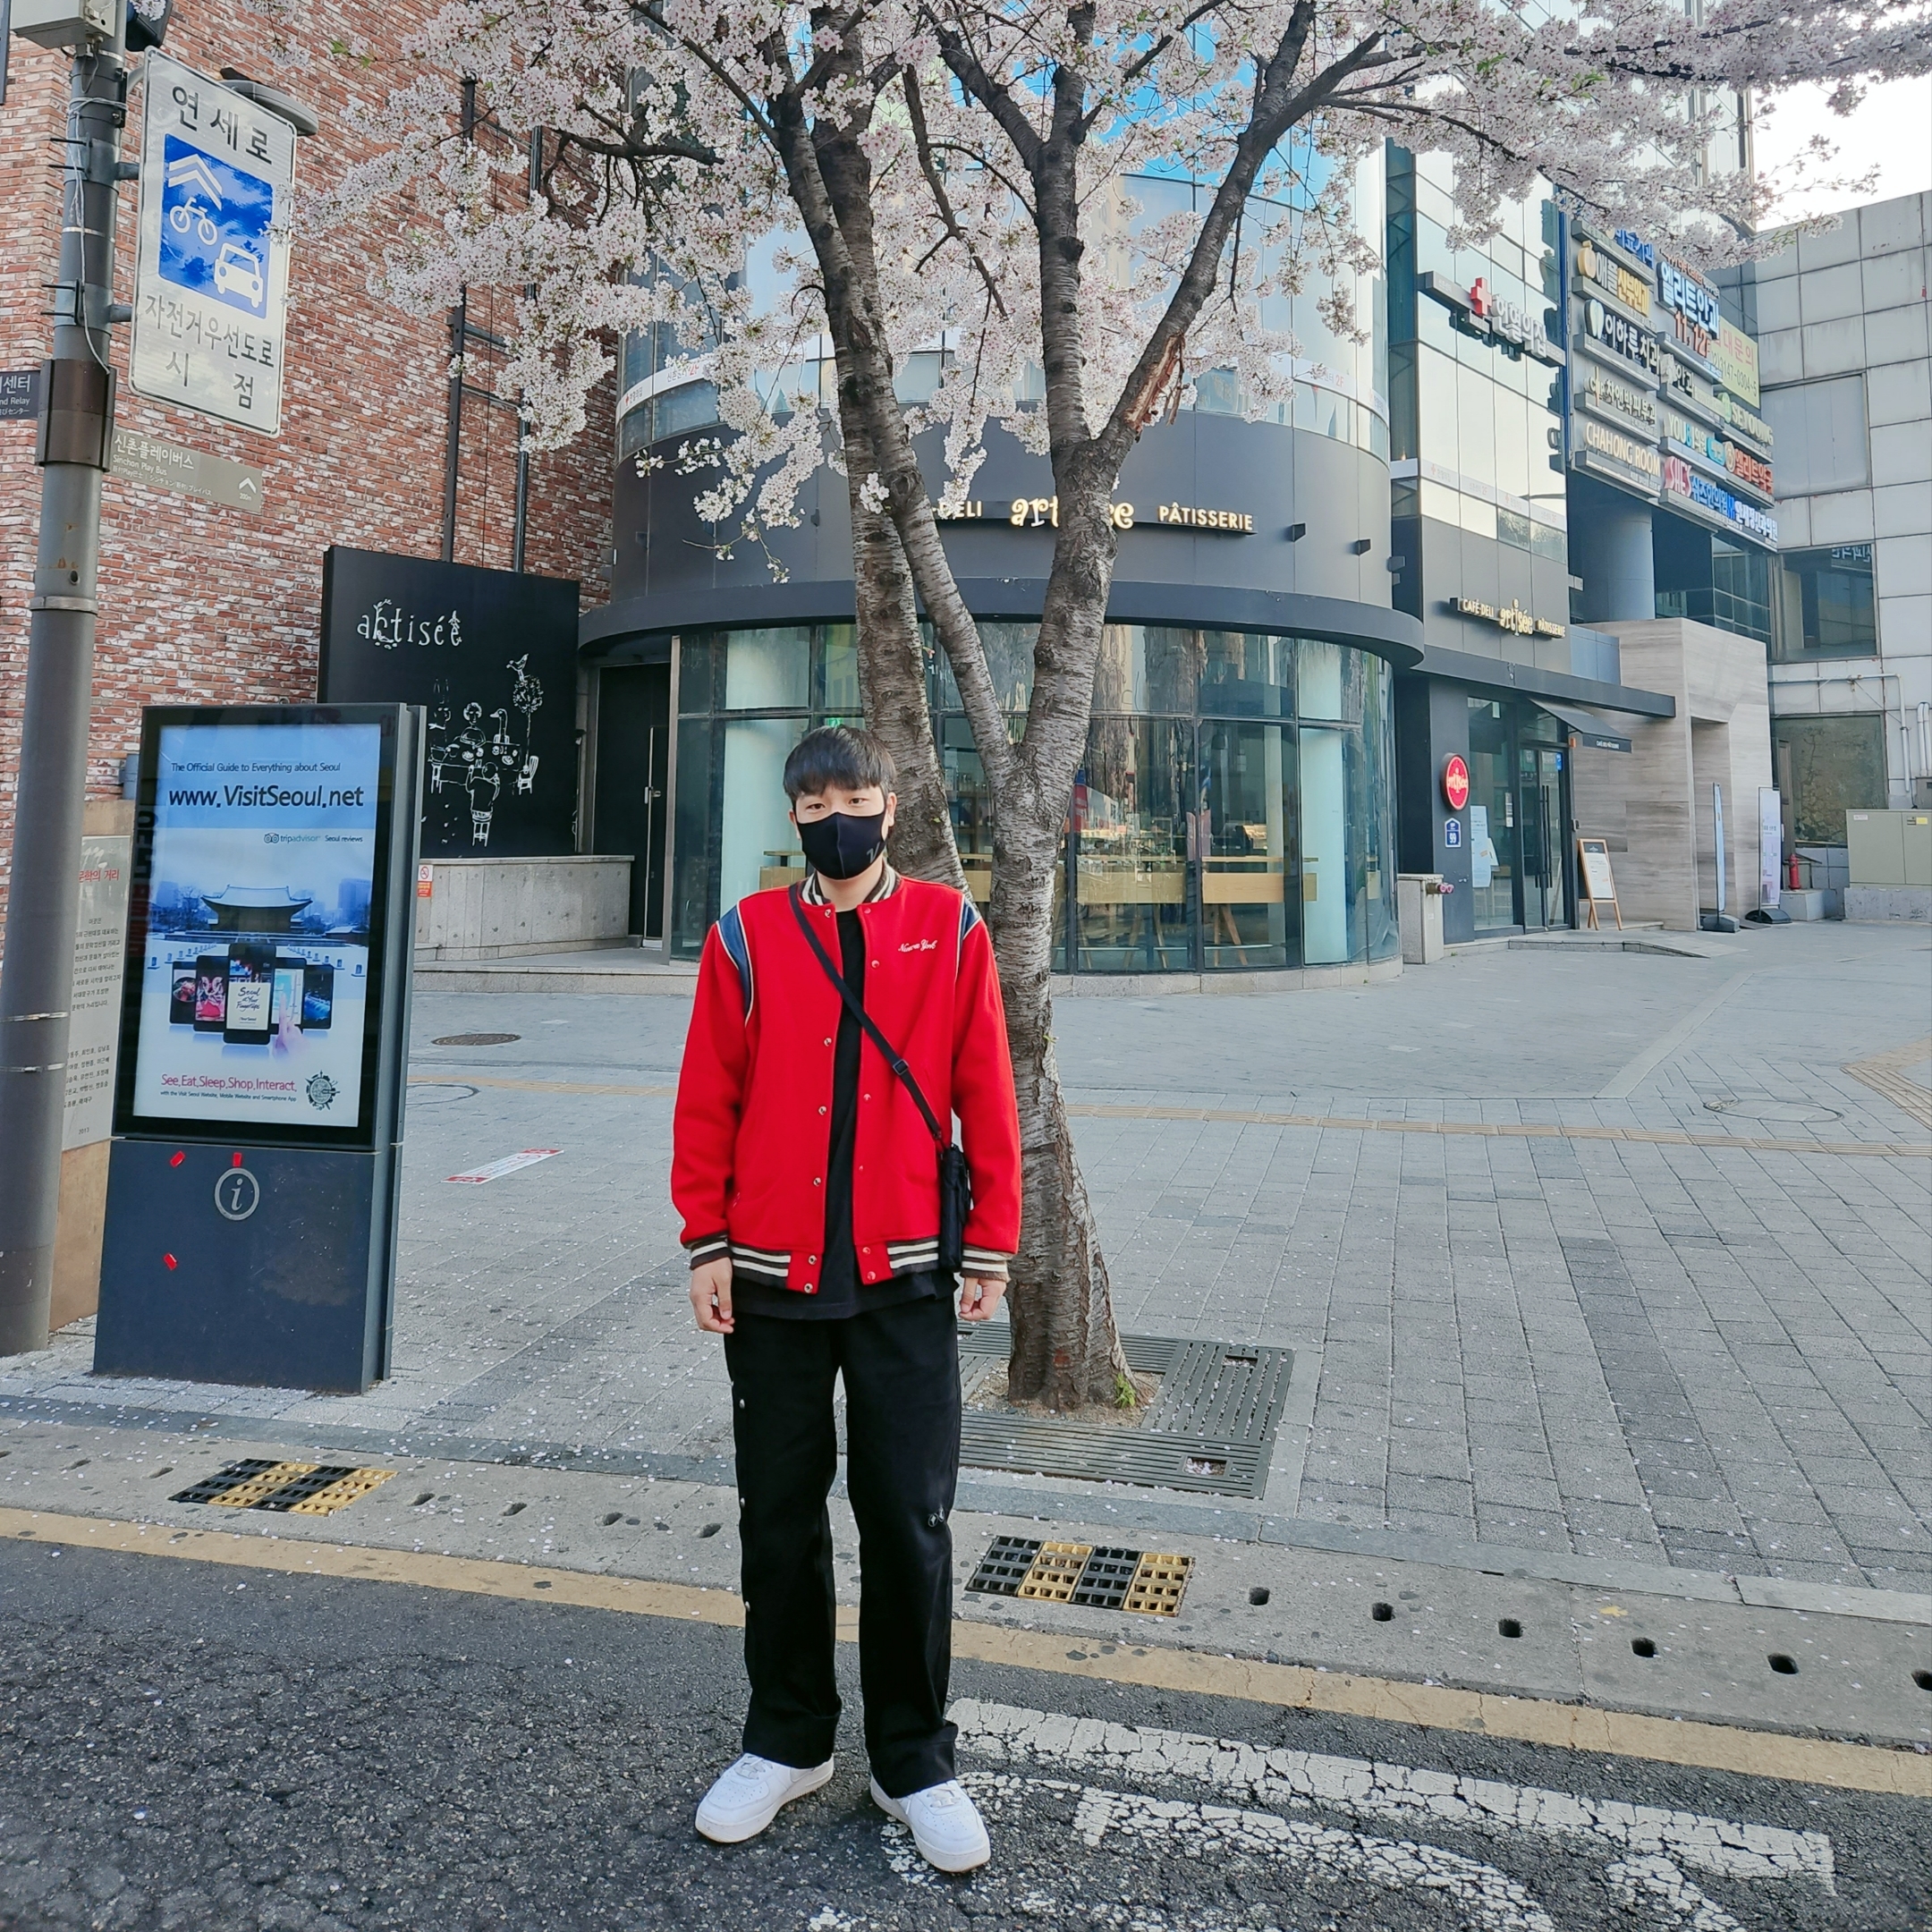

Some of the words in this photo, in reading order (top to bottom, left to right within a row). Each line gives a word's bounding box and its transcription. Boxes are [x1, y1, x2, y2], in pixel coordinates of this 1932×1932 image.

[172, 85, 273, 165] 연세로
[1661, 260, 1719, 340] 엘리트안과
[145, 294, 275, 368] 자전거우선도로
[1491, 293, 1547, 358] 헌혈의집
[11, 396, 30, 406] Relay
[114, 434, 194, 470] 신촌플레이버스
[1585, 421, 1633, 466] CHAHONG
[1635, 445, 1662, 478] ROOM
[113, 453, 140, 470] Sinchon
[140, 462, 155, 474] Play
[155, 467, 168, 477] Bus
[1158, 501, 1254, 531] PÂTISSERIE
[171, 763, 184, 773] The
[186, 762, 215, 773] Official
[216, 762, 240, 773] Guide
[241, 763, 250, 773] to
[251, 762, 292, 775] Everything
[293, 763, 318, 773] about
[319, 763, 341, 773] Seoul
[169, 784, 365, 809] www.VisitSeoul.net
[280, 834, 319, 844] tripadvisor
[324, 835, 341, 843] Seoul
[341, 835, 364, 843] reviews
[104, 869, 120, 882] 거리
[920, 938, 938, 952] York
